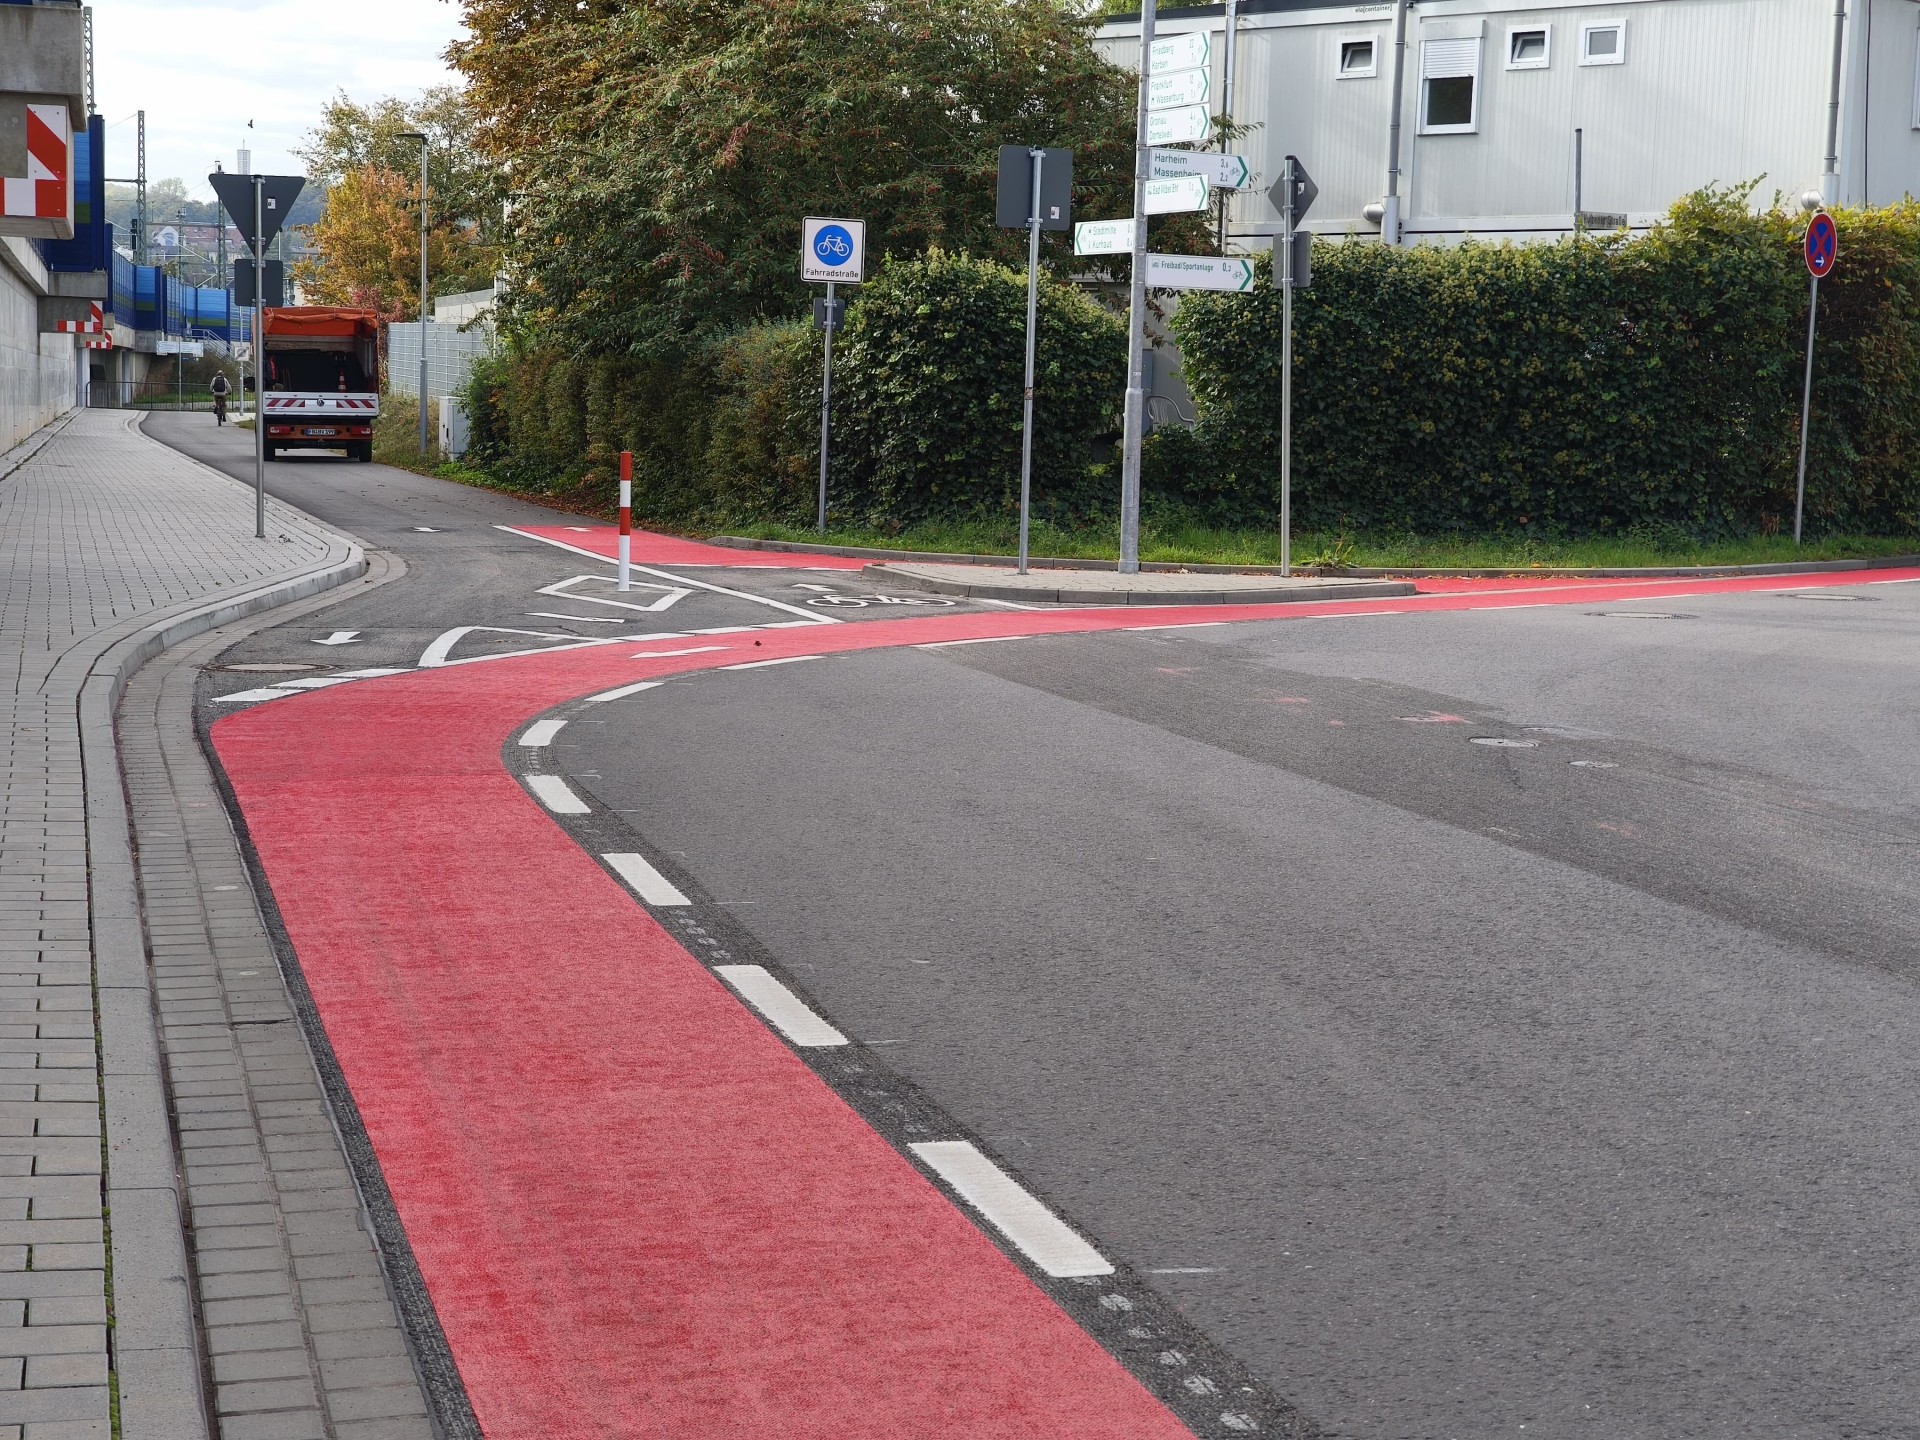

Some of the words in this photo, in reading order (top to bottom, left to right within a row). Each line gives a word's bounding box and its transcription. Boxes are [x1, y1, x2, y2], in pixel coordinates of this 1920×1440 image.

[1152, 44, 1174, 55] Friedberg
[1151, 60, 1168, 70] Karben
[1151, 79, 1173, 91] Frankfurt
[1156, 92, 1184, 104] Wasserburg
[1149, 116, 1167, 126] Gronau
[1155, 153, 1187, 165] Harheim
[1154, 167, 1202, 178] Massenheim
[1093, 226, 1117, 235] Stadtmitte
[1093, 239, 1112, 249] Kurhaus
[1161, 261, 1214, 273] Freibad/Sportanlage
[806, 268, 859, 278] Fahrradstraße
